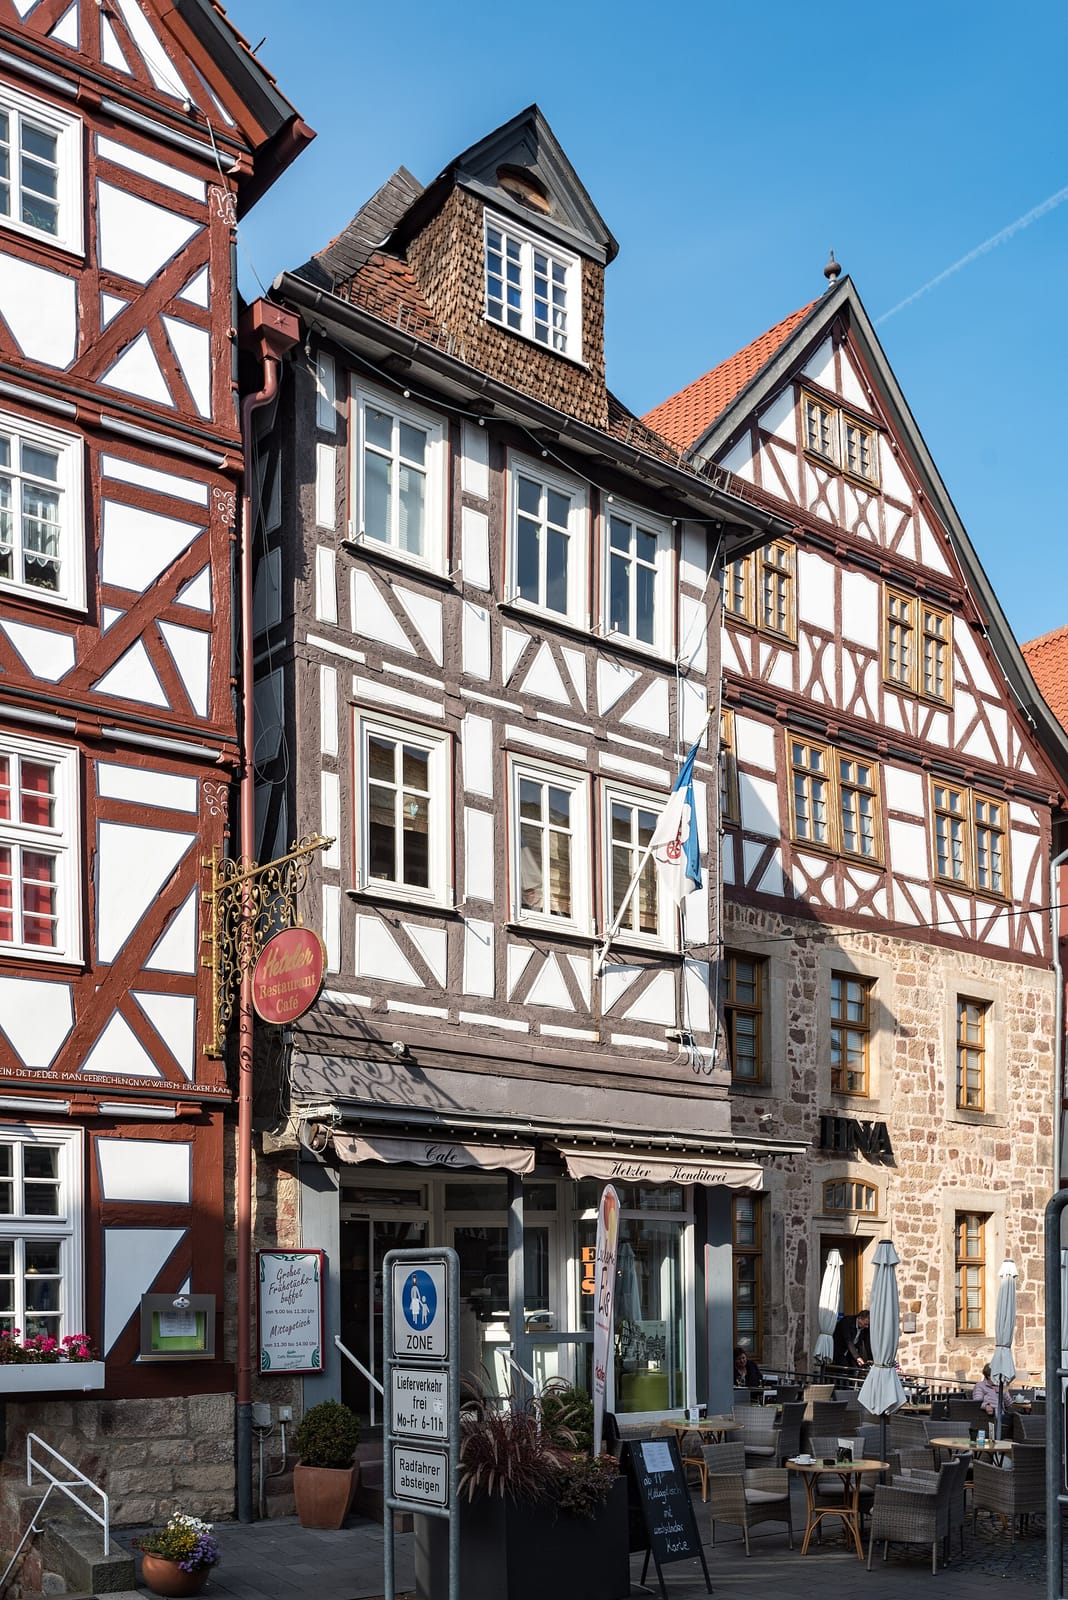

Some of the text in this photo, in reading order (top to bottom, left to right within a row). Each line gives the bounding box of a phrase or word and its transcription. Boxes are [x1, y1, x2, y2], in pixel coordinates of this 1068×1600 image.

[259, 971, 316, 999] Restaurant
[276, 994, 299, 1014] Café
[818, 1115, 894, 1156] HNA
[610, 1161, 728, 1181] Hetzler Konditorei
[581, 1246, 597, 1295] EIS
[269, 1315, 311, 1339] Mittagstisch
[406, 1334, 433, 1351] ZONE
[397, 1375, 443, 1393] Lieferverkehr
[413, 1395, 427, 1410] frei
[397, 1412, 417, 1428] Mo-Fr
[399, 1458, 440, 1476] Radfahrer
[400, 1475, 440, 1494] absteigen
